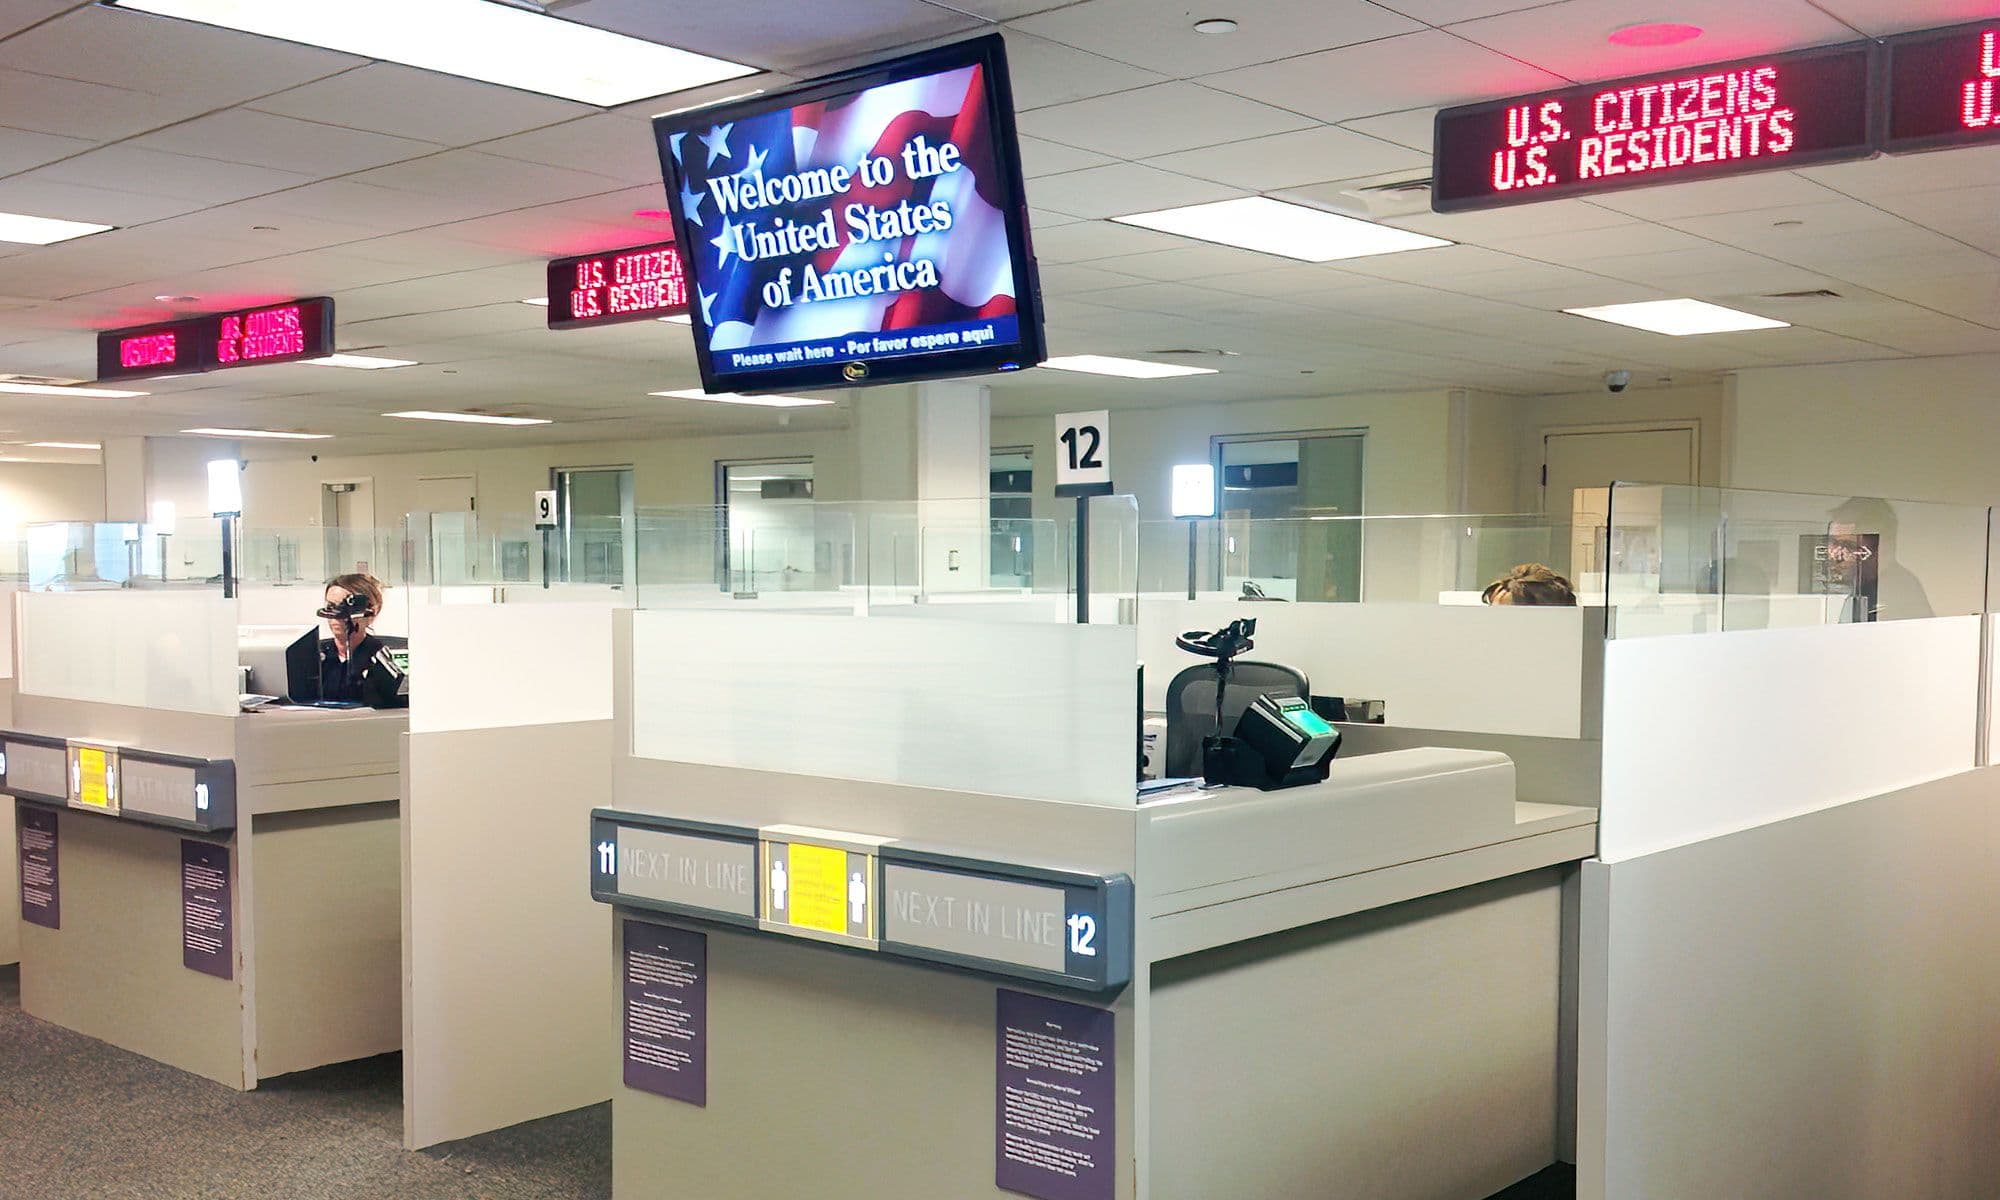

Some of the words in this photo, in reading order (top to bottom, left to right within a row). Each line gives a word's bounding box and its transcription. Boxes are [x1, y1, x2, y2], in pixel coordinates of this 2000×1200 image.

[1507, 101, 1571, 147] U.S.
[1593, 67, 1777, 134] CITIZENS
[1493, 145, 1557, 190] U.S.
[1578, 109, 1795, 179] RESIDENTS
[707, 164, 852, 215] Welcome
[857, 151, 895, 188] to
[901, 135, 960, 180] the
[732, 208, 840, 262] United
[844, 199, 953, 244] States
[615, 249, 683, 283] CITIZEN
[762, 267, 794, 308] of
[800, 252, 939, 303] America
[732, 352, 774, 367] Please
[774, 347, 804, 362] wait
[804, 346, 834, 360] here
[846, 340, 871, 355] Por
[872, 337, 908, 352] favor
[910, 332, 959, 349] espere
[1060, 425, 1102, 470] 12
[540, 497, 549, 519] 9
[597, 841, 615, 875] 11
[623, 847, 671, 881] NEXT
[679, 857, 698, 887] IN
[704, 860, 747, 895] LINE
[894, 889, 957, 929] NEXT
[966, 901, 990, 936] IN
[1001, 905, 1058, 946] LINE
[1066, 913, 1096, 957] 12
